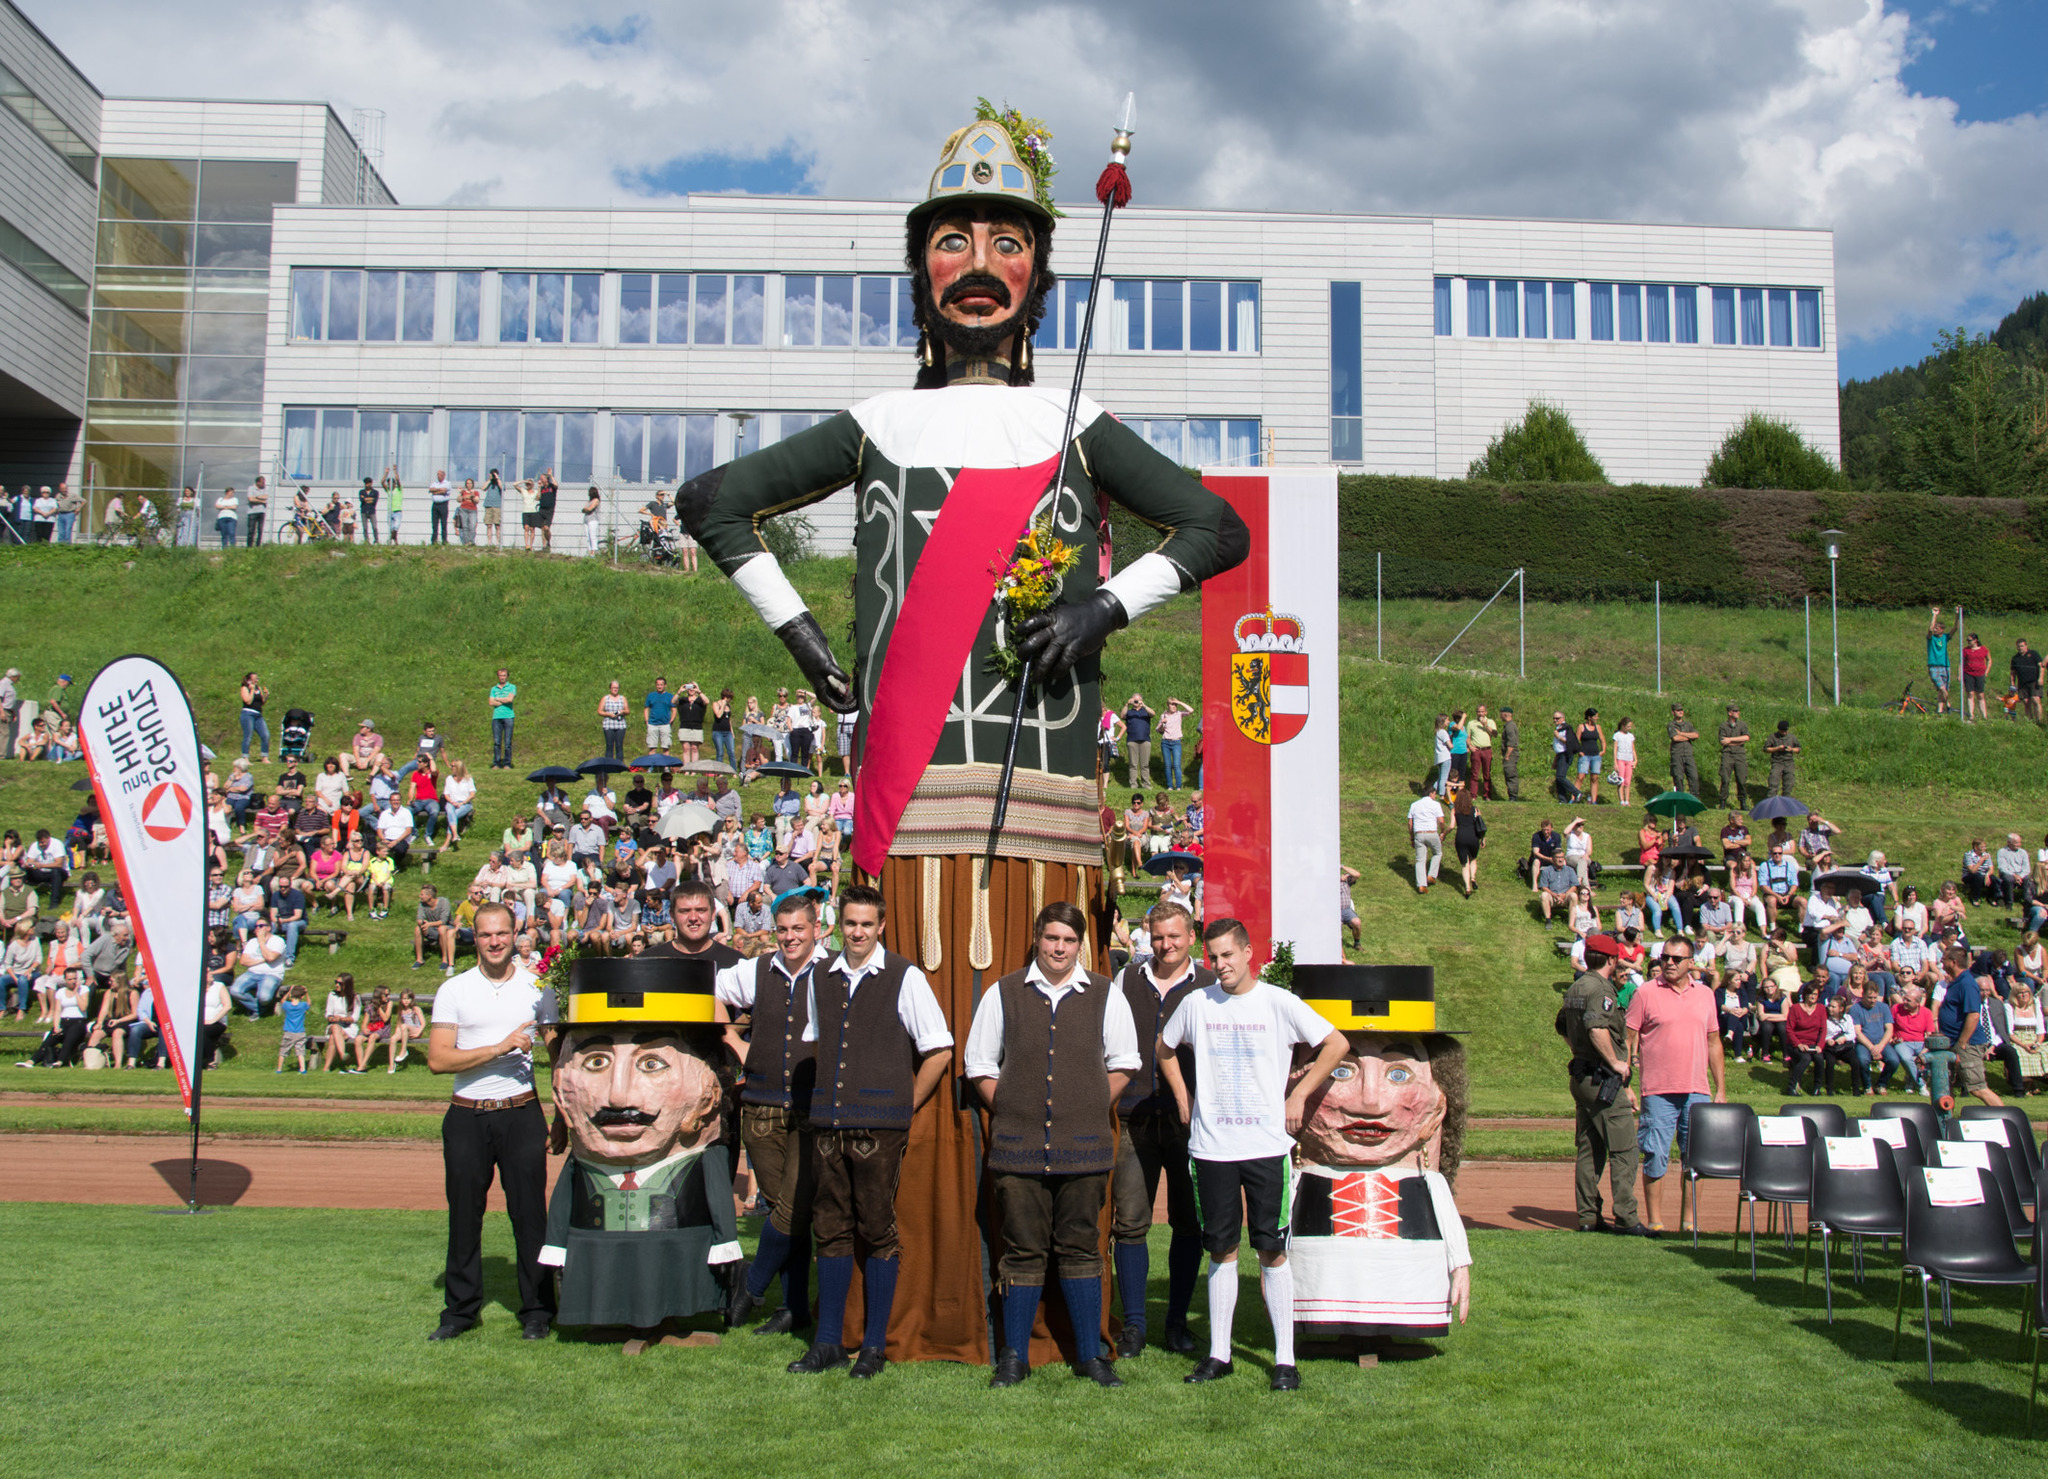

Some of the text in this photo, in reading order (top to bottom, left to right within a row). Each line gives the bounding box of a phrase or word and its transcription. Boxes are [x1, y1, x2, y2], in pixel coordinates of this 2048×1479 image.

[1206, 1023, 1266, 1032] BIER UNSER
[1217, 1116, 1262, 1126] PROST
